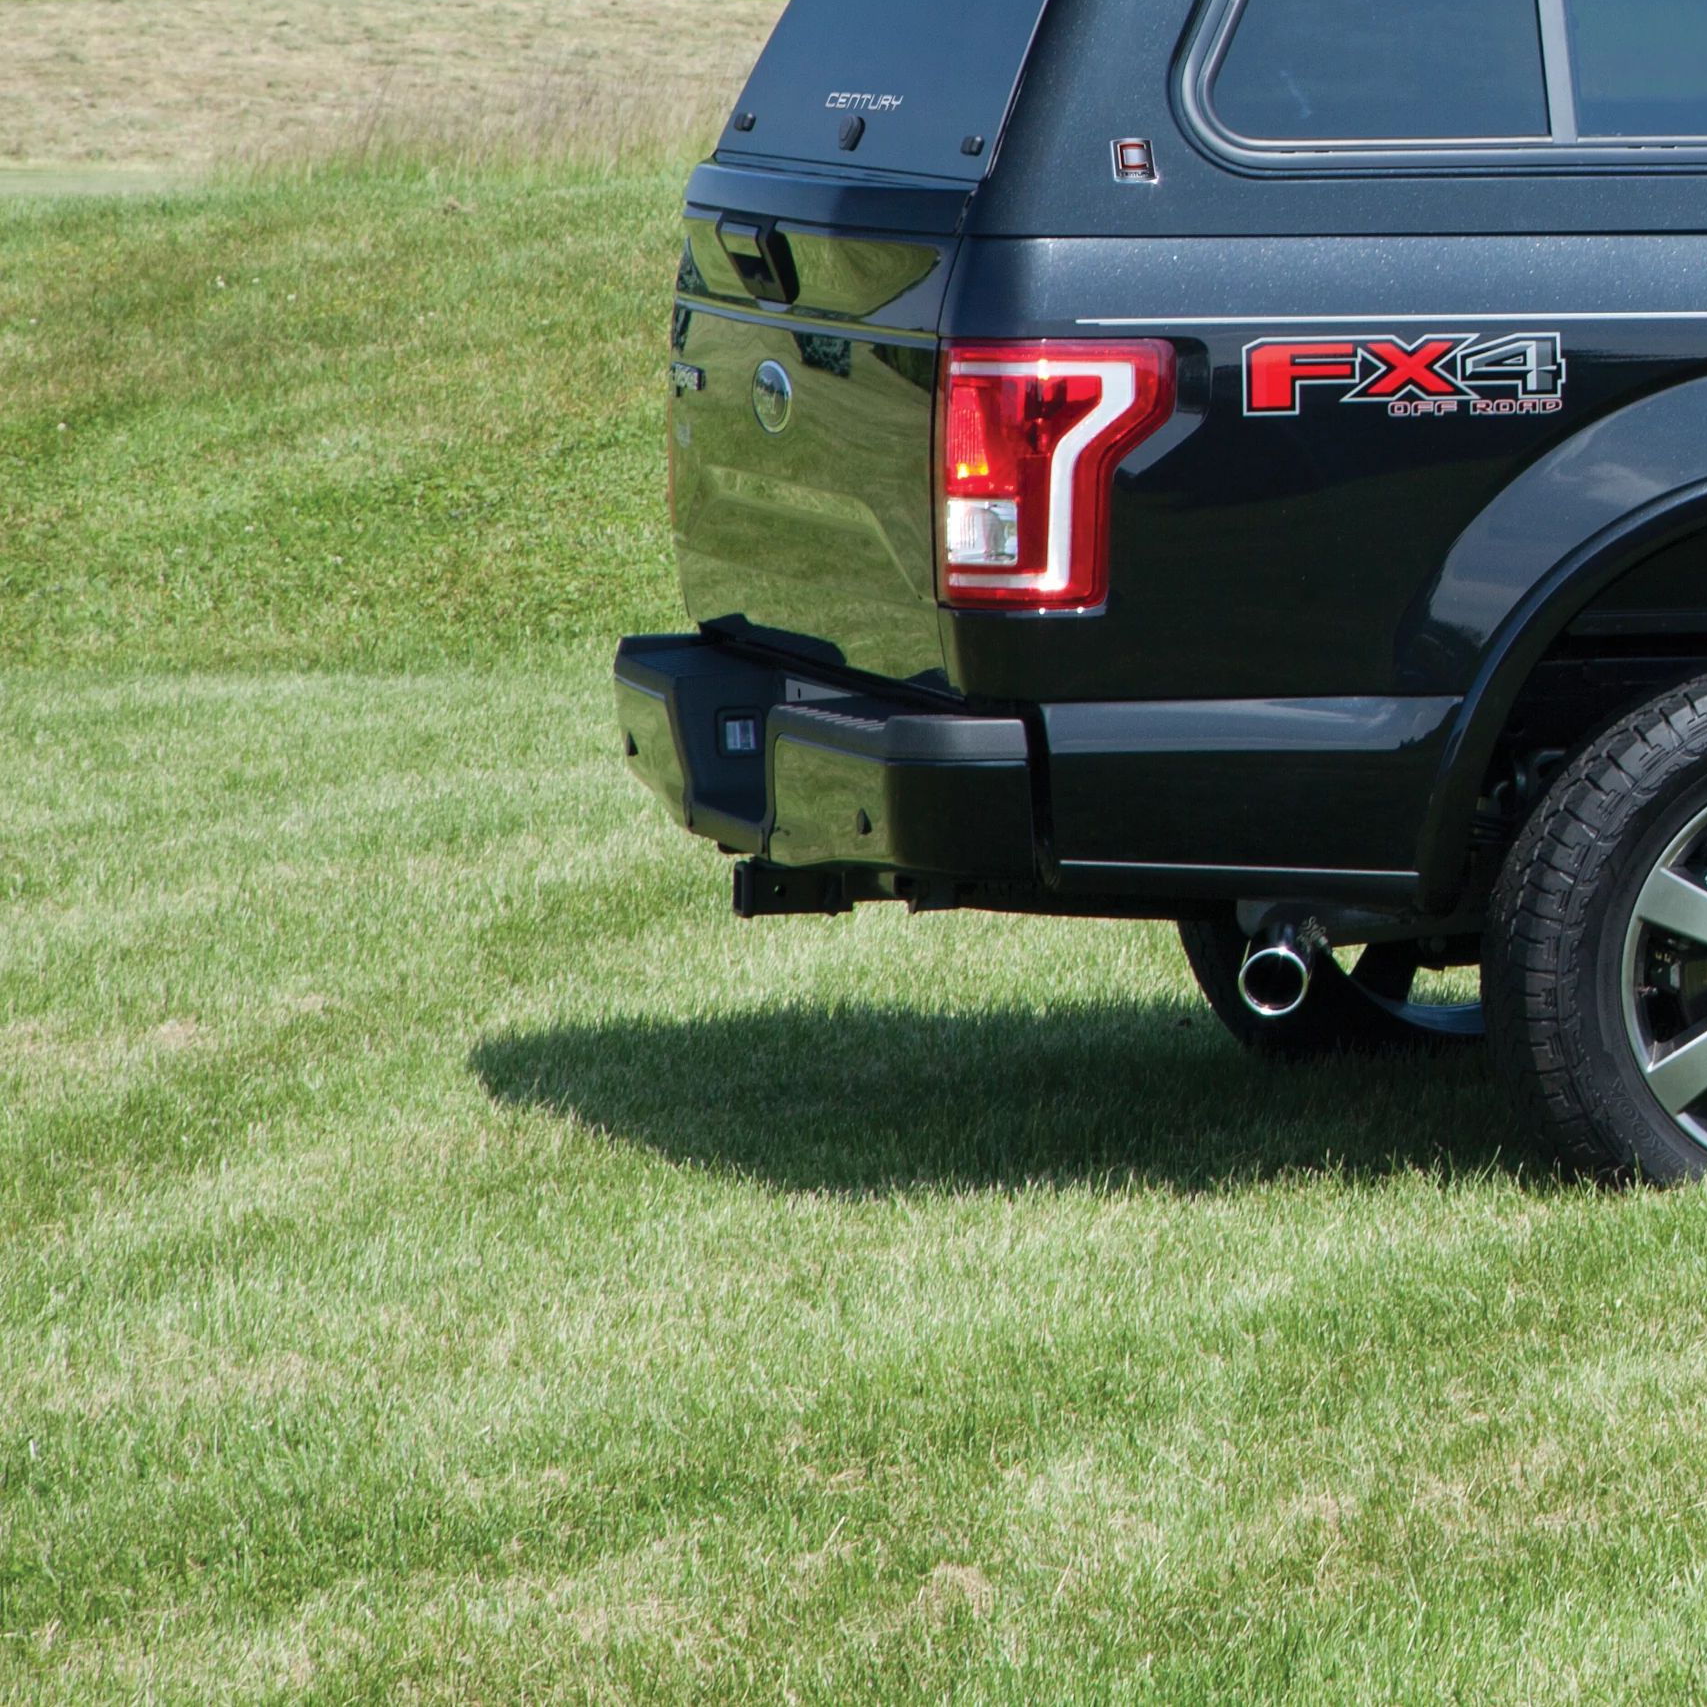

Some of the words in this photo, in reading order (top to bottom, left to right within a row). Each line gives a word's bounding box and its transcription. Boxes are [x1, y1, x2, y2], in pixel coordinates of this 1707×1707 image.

[825, 92, 904, 111] CENTURY
[1242, 332, 1566, 416] FX4
[1388, 399, 1458, 417] OFF
[1470, 398, 1563, 415] ROAD
